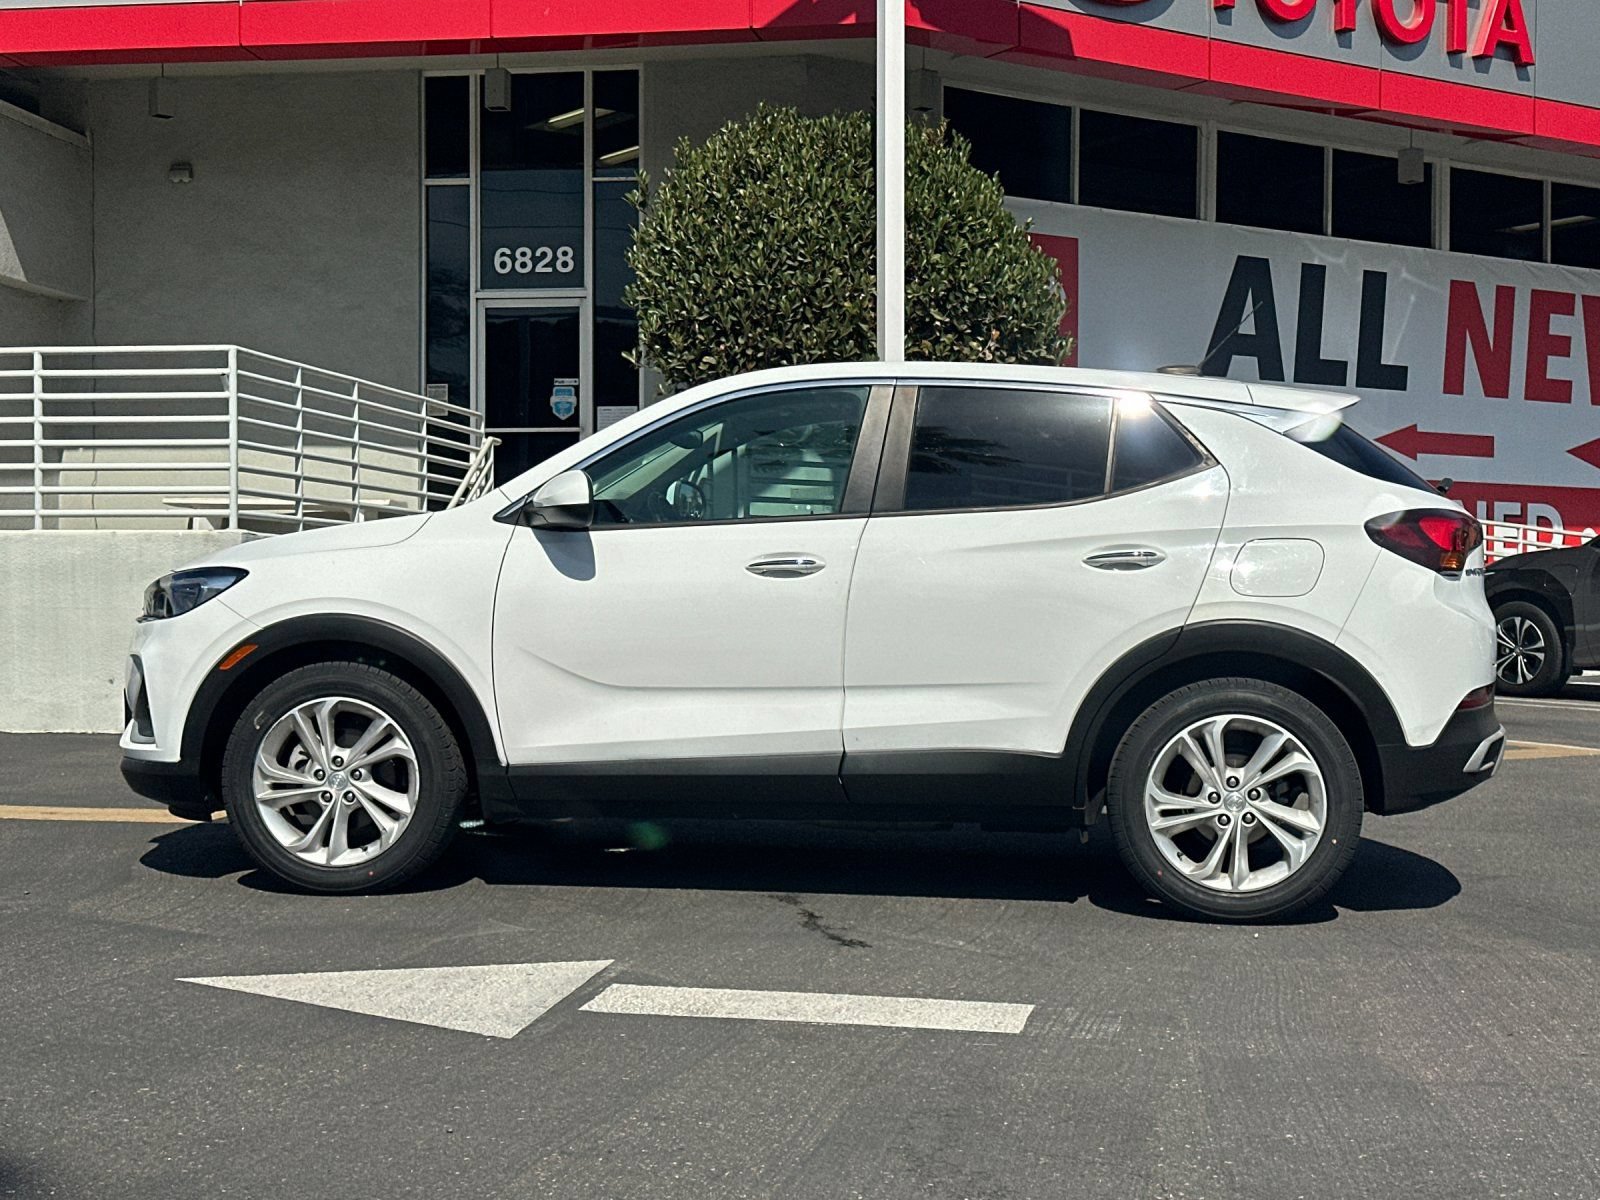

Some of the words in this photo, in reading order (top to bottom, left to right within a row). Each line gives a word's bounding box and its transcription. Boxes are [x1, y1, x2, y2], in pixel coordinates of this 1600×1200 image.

[1213, 0, 1536, 66] OTA
[493, 246, 575, 274] 6828
[1205, 254, 1408, 391] ALL
[1442, 279, 1600, 406] NE
